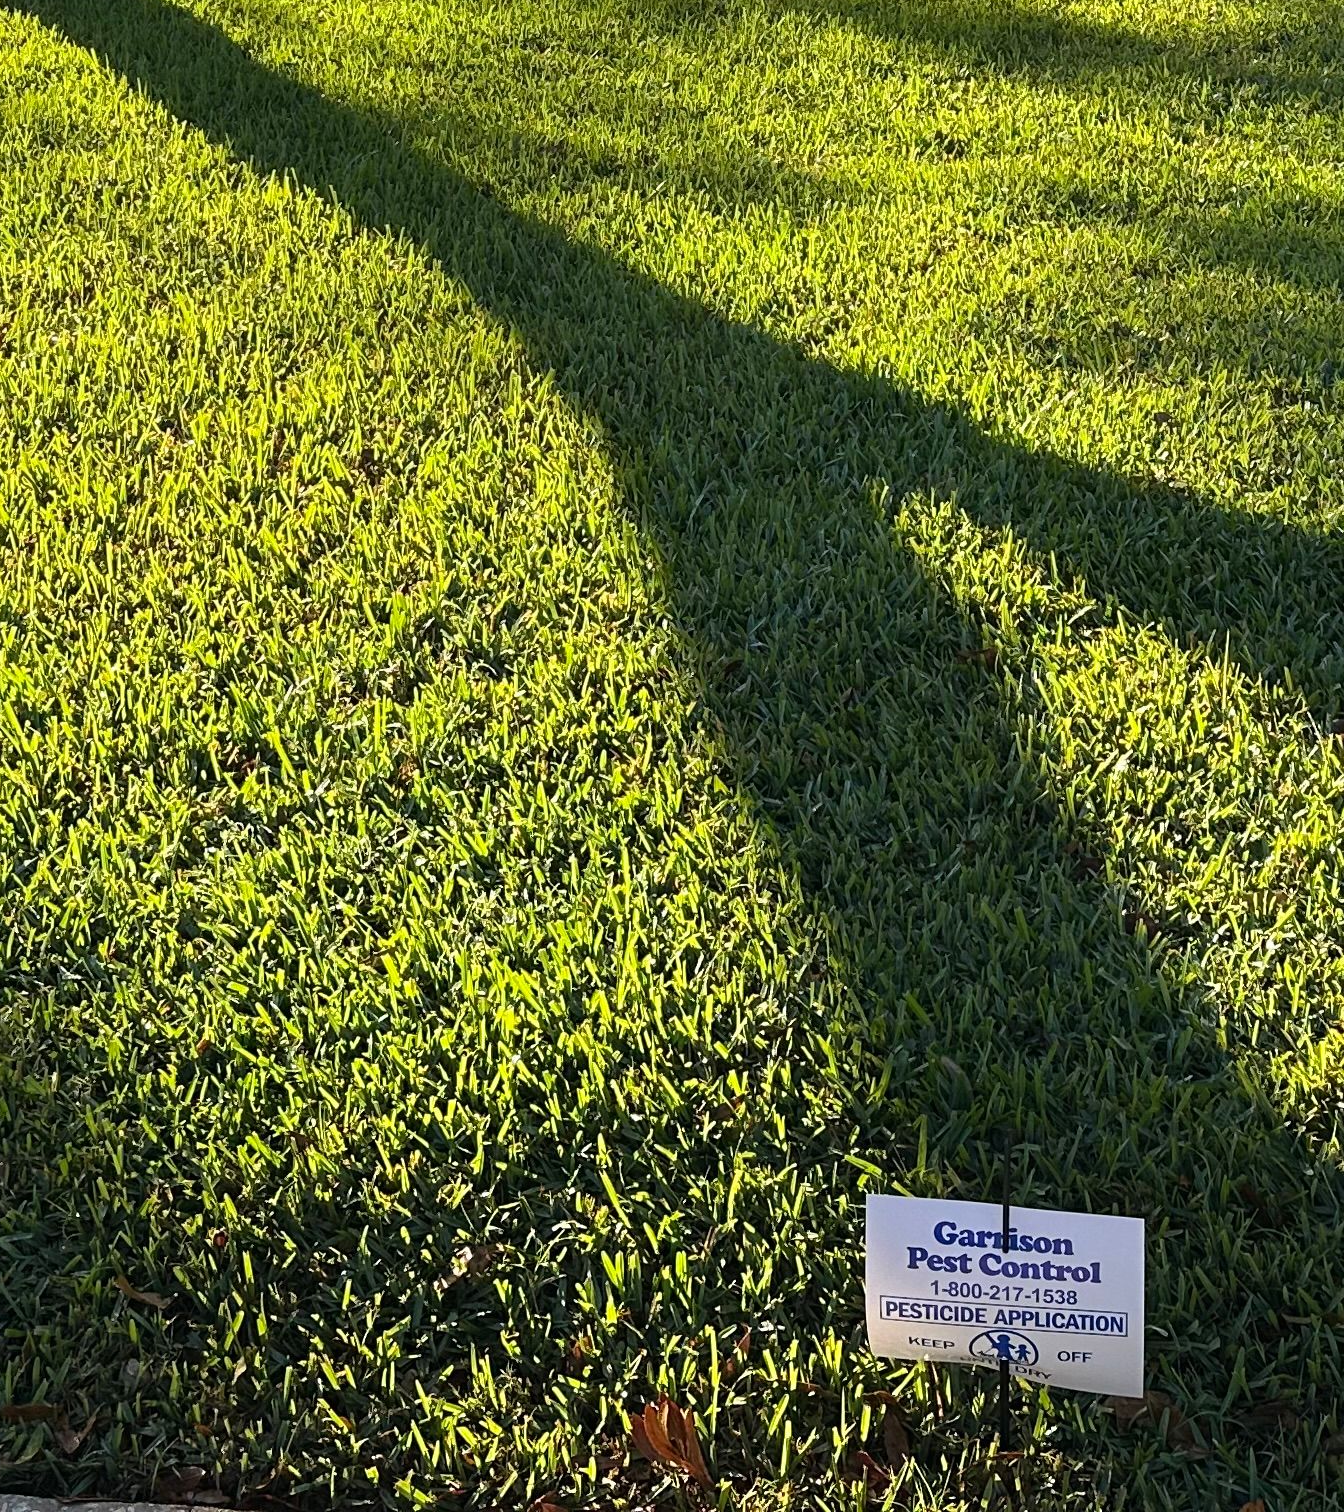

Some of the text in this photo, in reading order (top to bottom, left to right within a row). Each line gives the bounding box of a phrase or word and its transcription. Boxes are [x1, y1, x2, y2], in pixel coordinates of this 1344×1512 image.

[933, 1220, 1074, 1256] Garrison
[906, 1246, 1102, 1284] Pest Control
[930, 1279, 1078, 1306] 1-800-217-1538
[885, 1300, 1124, 1334] PESTICIDE APPLICATION
[908, 1336, 1093, 1363] KEEP OFF
[1015, 1365, 1052, 1380] DRY
